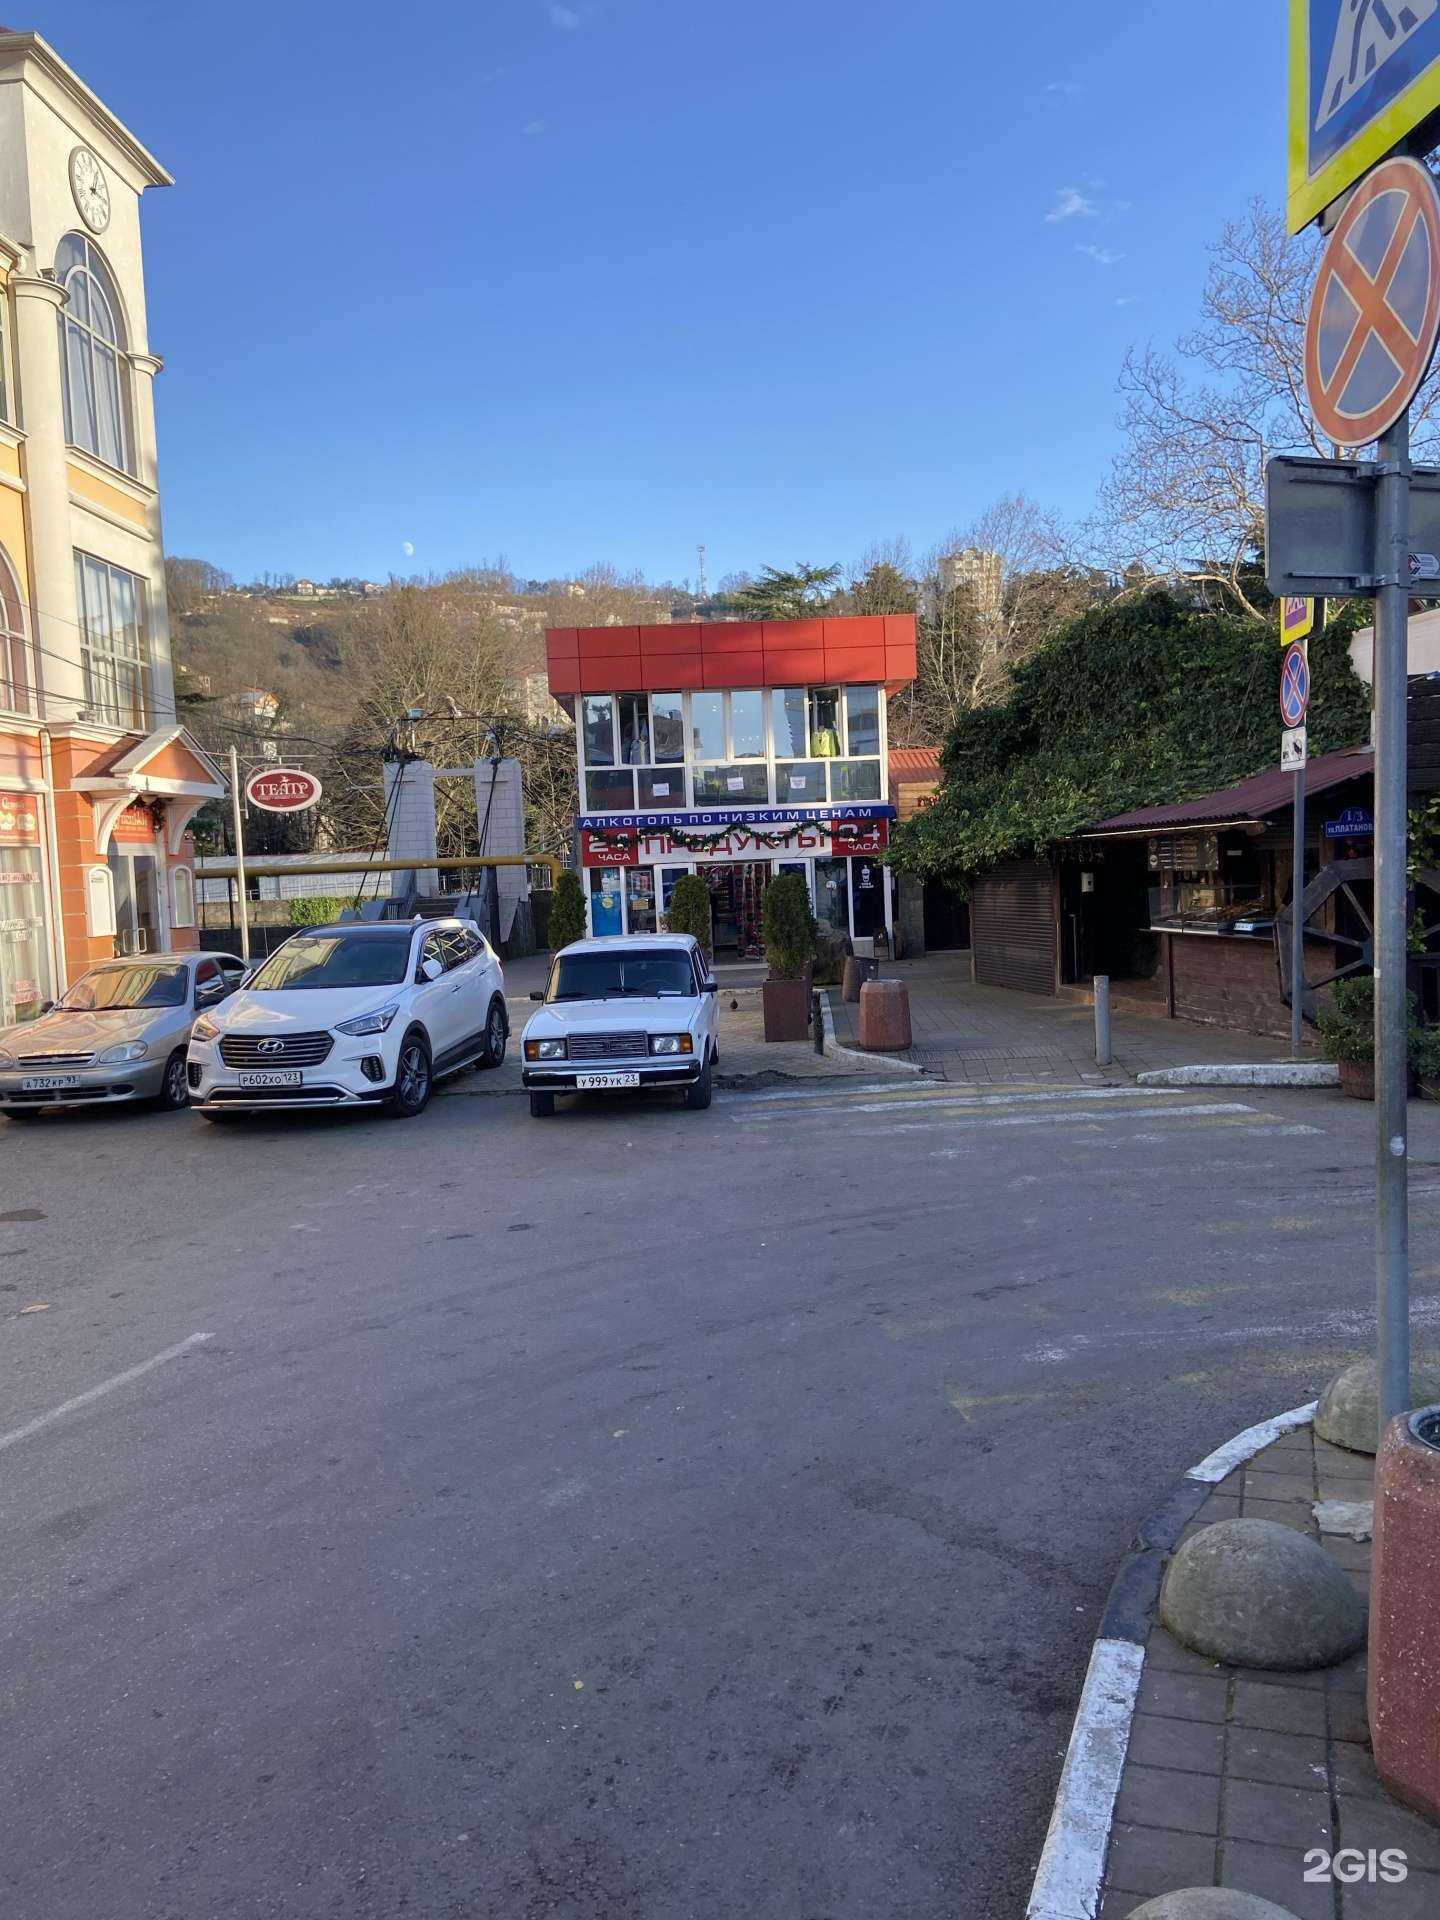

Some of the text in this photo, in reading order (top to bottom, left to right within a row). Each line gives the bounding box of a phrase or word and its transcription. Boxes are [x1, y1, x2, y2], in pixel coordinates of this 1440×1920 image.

[256, 782, 309, 796] ТЕАТР
[582, 808, 871, 827] АЛКОГОЛЬ ПО НИЗКИМ ЦЕНАМ
[848, 843, 880, 851] ЧАСА
[598, 853, 631, 861] ЧАСА
[283, 1072, 298, 1081] 123
